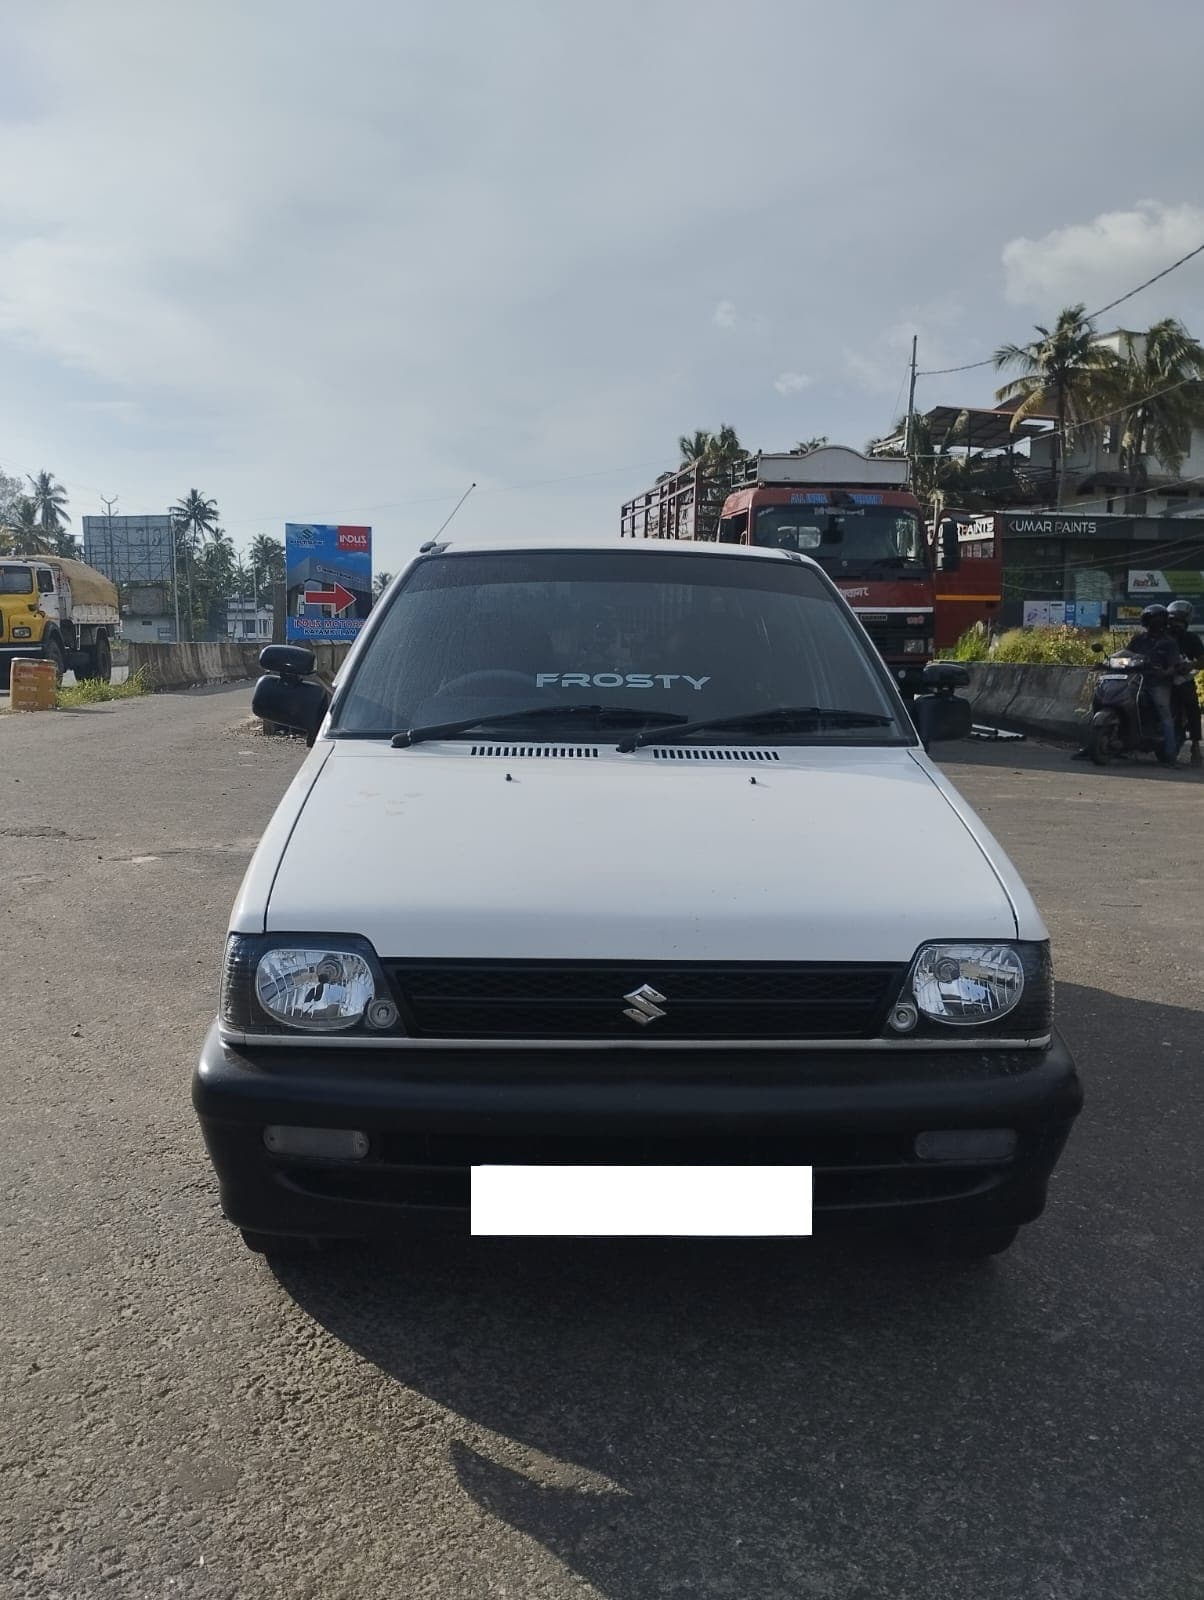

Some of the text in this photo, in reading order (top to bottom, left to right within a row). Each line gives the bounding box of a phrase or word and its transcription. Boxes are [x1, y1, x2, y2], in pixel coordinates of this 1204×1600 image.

[1008, 520, 1097, 533] KUMAR PAINTS
[339, 534, 368, 545] INDUS
[535, 672, 711, 690] FROSTY
